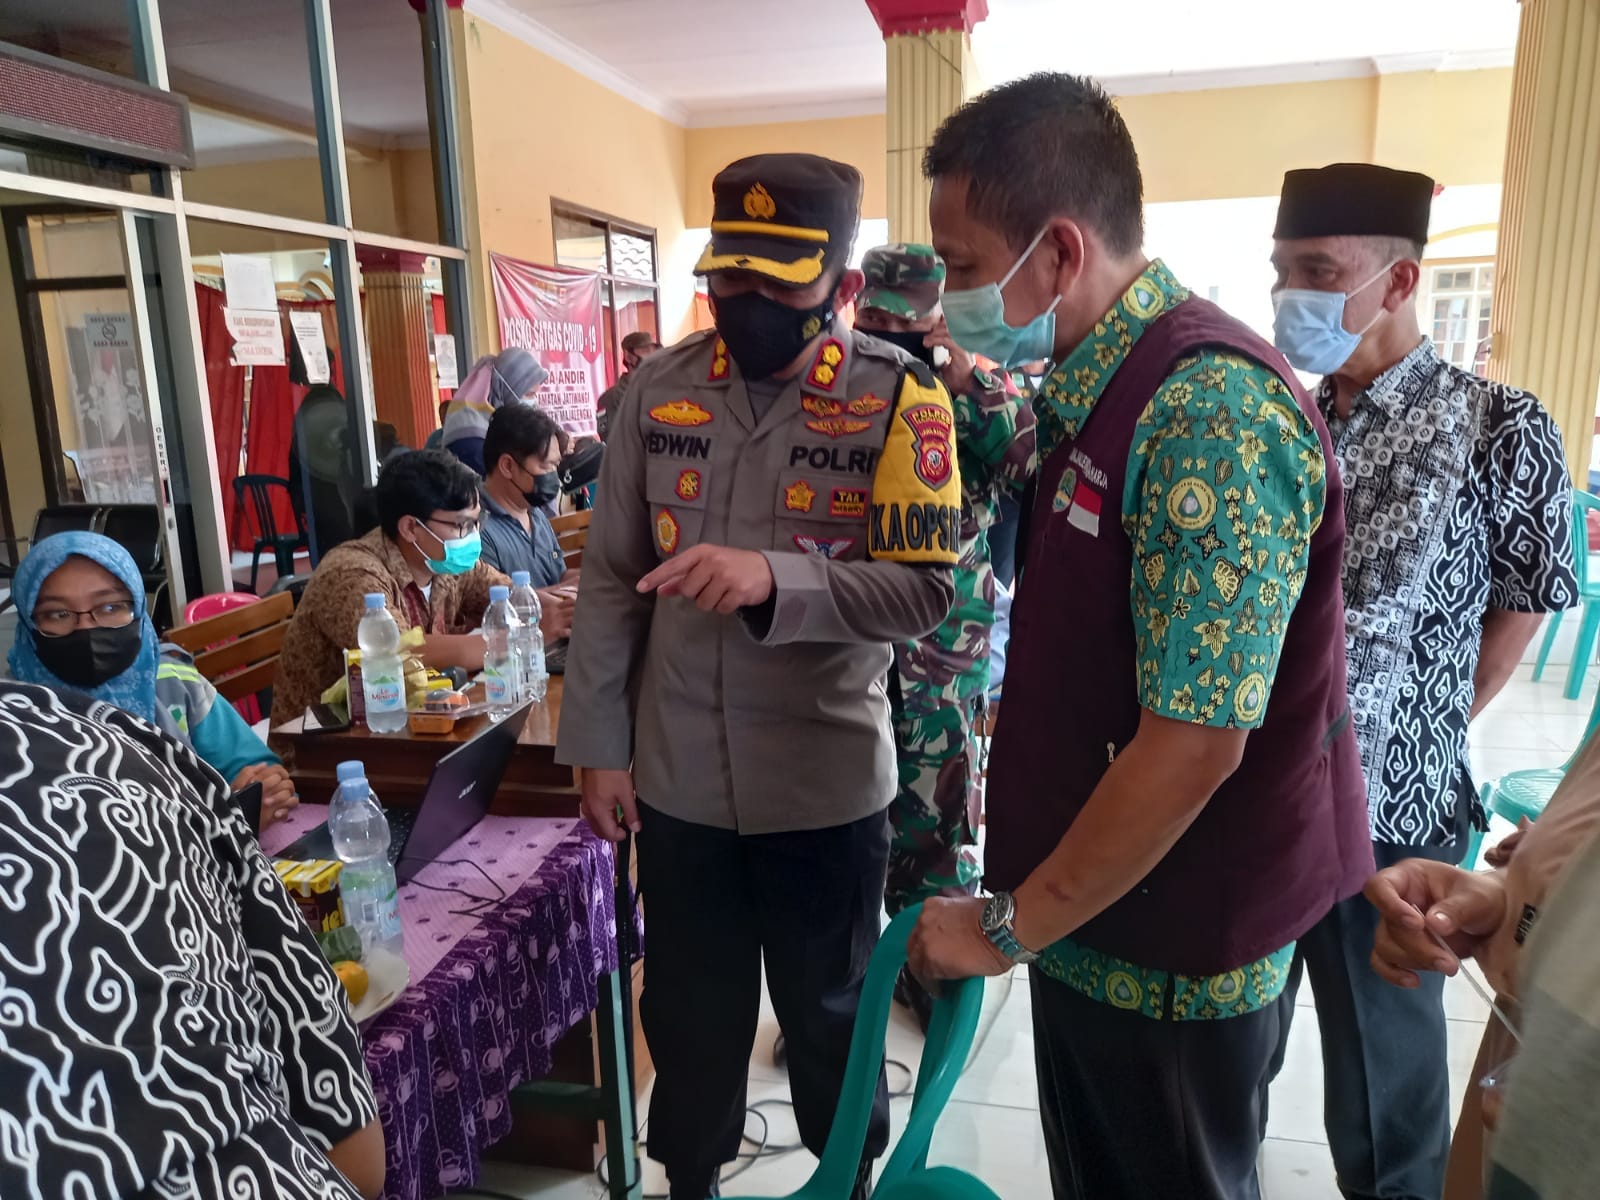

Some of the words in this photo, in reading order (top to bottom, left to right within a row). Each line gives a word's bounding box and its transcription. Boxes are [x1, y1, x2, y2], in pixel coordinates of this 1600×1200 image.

[504, 317, 532, 349] POSKO
[533, 319, 562, 351] SATGAS
[563, 322, 584, 353] COVID
[588, 324, 597, 353] 19
[558, 370, 586, 385] ANDIR
[912, 407, 951, 426] POLRES
[648, 432, 711, 460] EDWIN
[789, 445, 875, 475] POLRI
